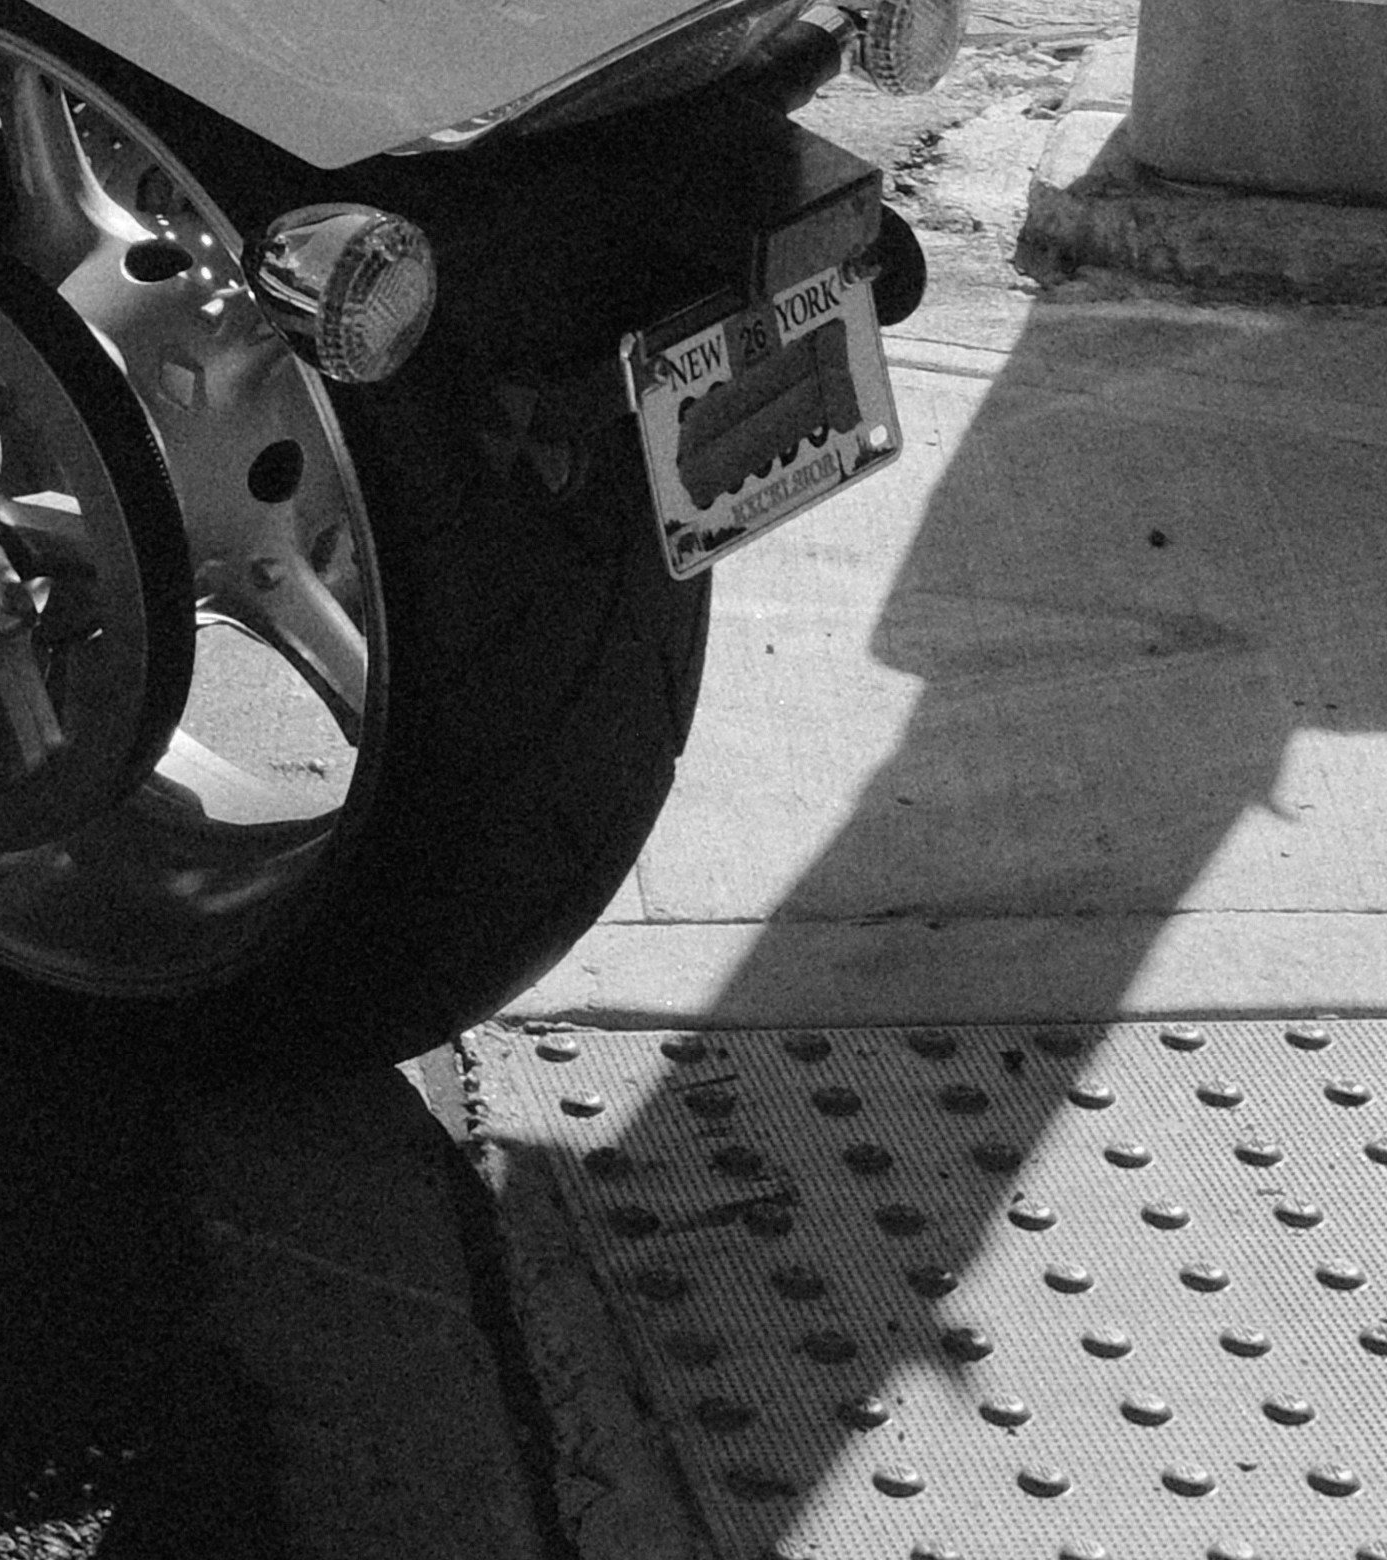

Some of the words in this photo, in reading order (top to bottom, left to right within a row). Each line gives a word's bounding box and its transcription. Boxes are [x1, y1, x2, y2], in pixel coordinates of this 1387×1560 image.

[667, 334, 723, 392] NEW
[774, 275, 841, 333] YORK
[739, 320, 768, 357] 26
